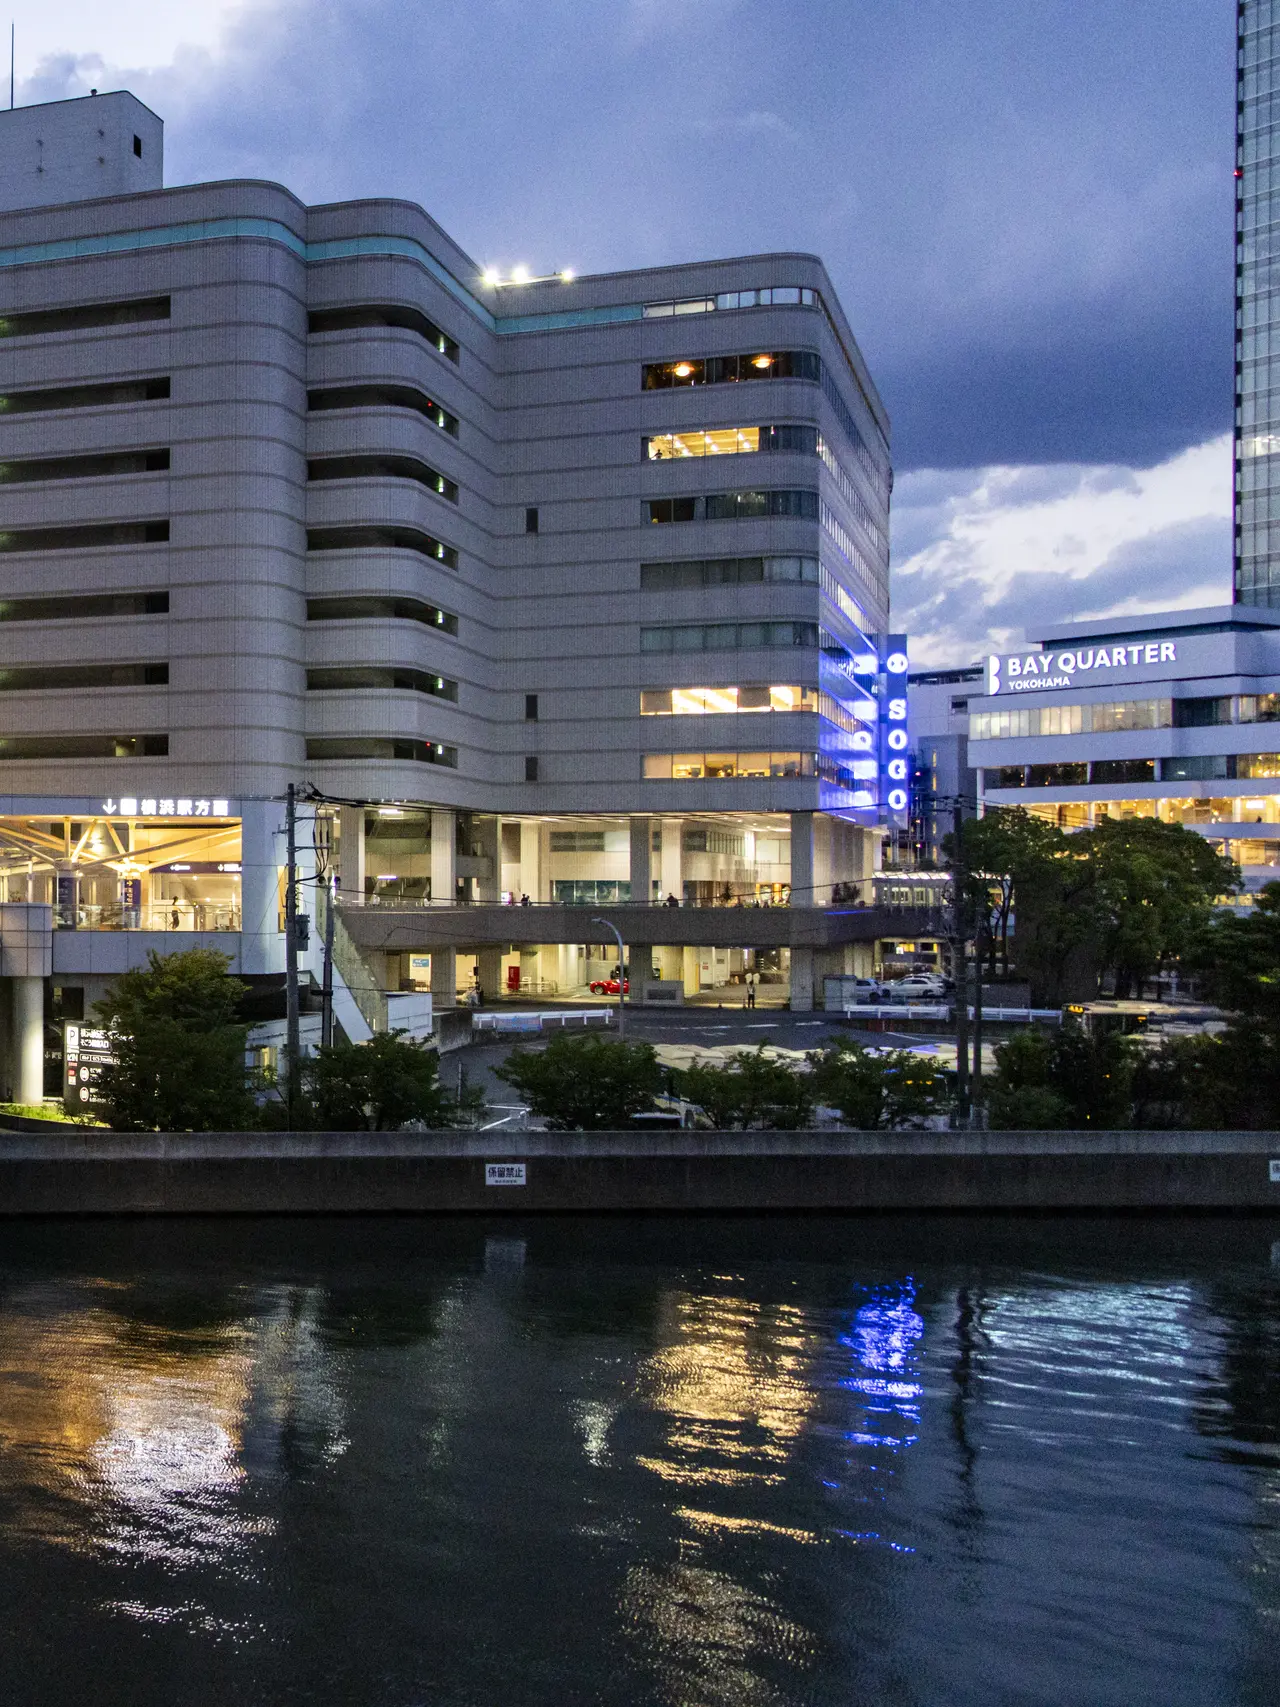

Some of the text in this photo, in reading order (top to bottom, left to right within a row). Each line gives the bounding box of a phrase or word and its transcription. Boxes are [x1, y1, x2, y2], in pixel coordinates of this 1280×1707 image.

[1008, 642, 1176, 677] BAY QUARTER
[1008, 676, 1071, 691] YOKOHAMA
